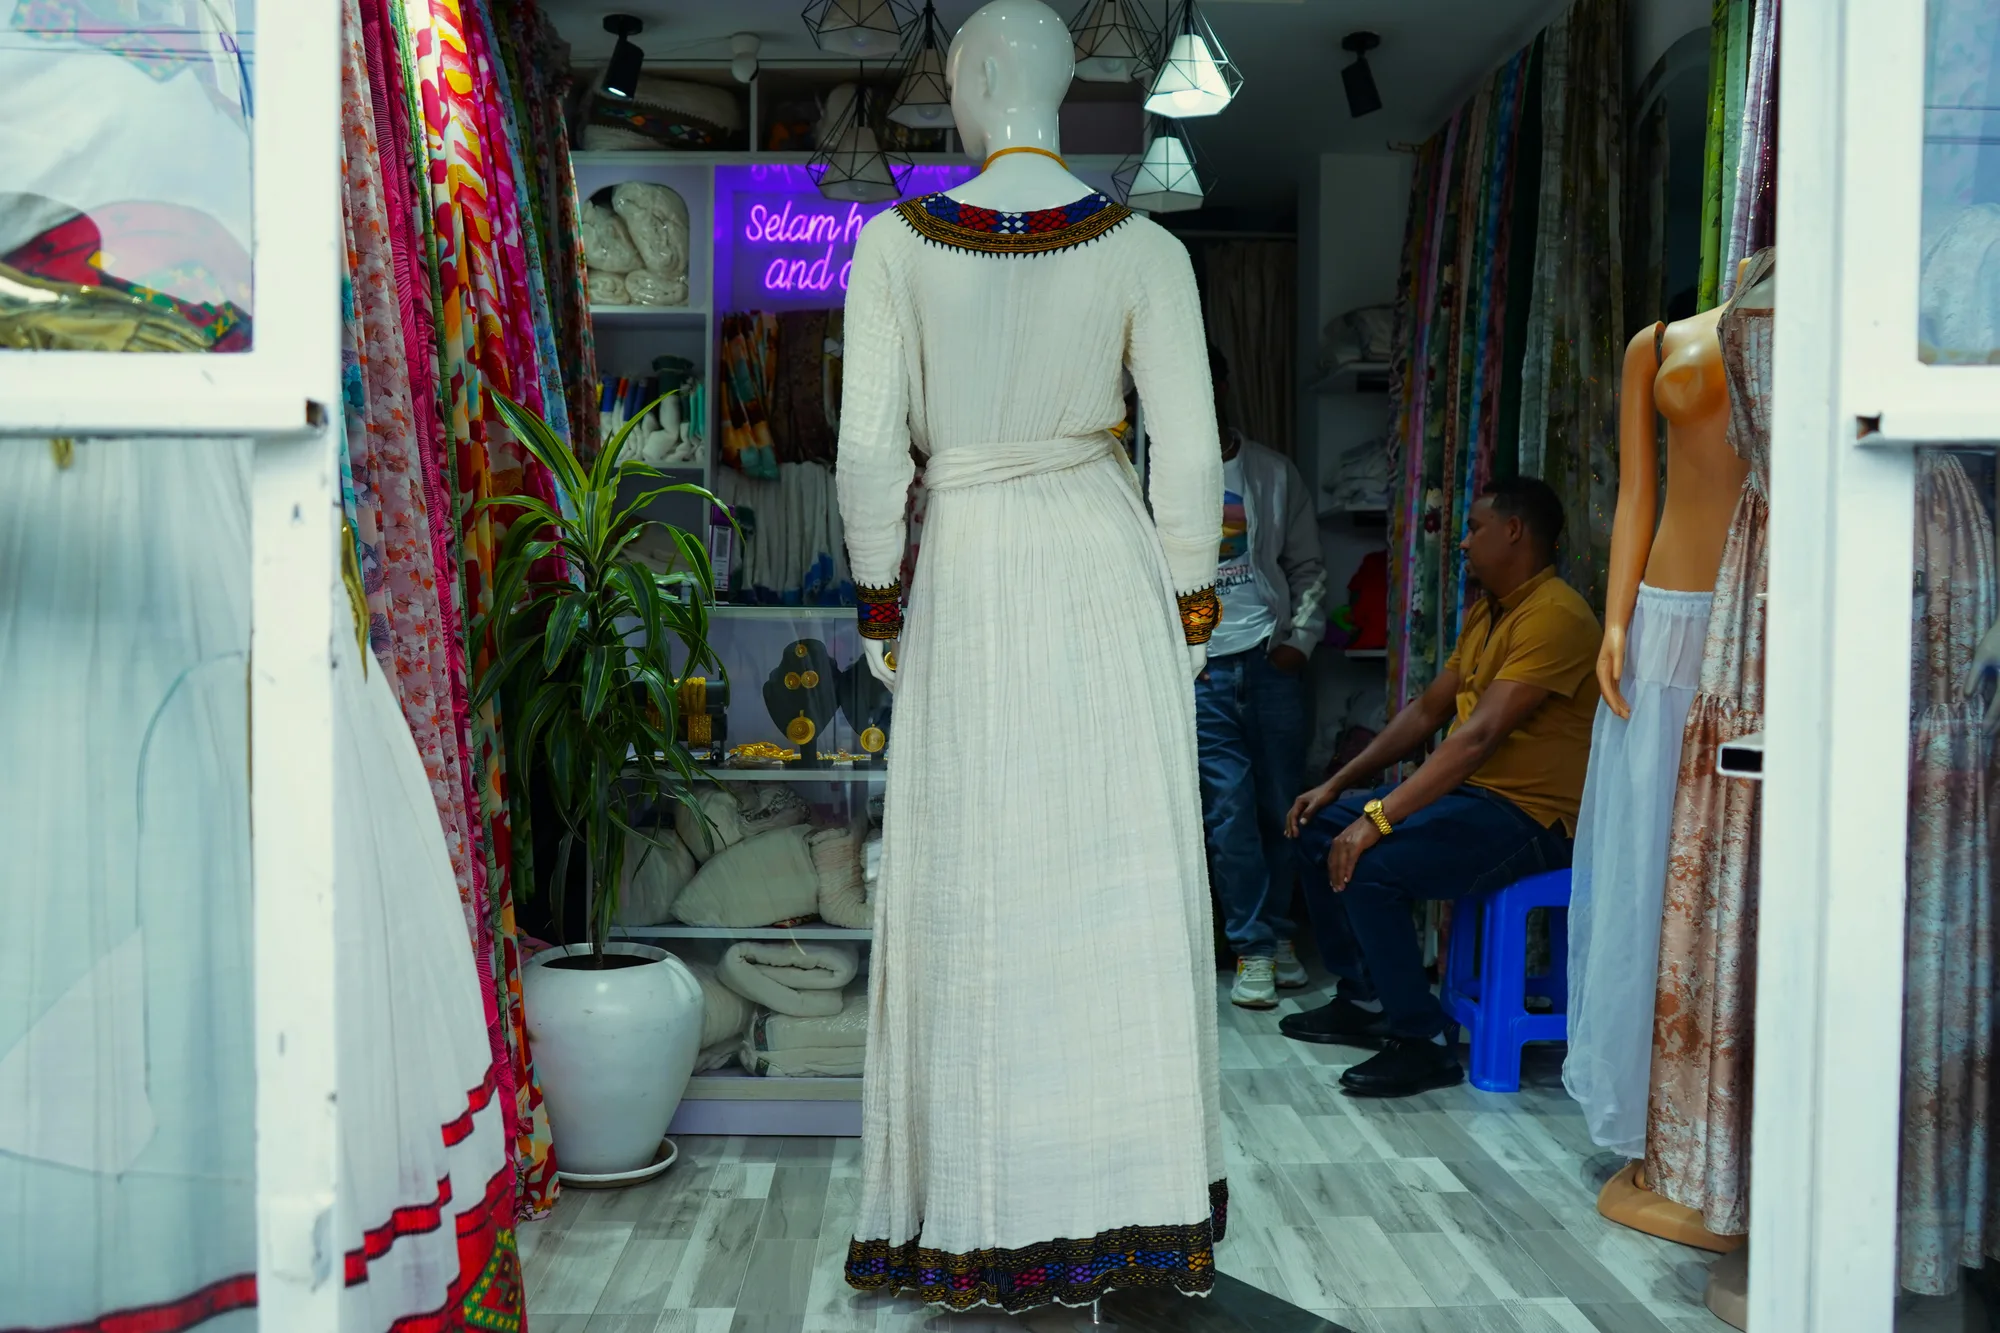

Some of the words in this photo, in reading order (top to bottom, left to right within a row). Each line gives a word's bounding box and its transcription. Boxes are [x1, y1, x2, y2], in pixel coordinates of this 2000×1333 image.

[745, 201, 842, 243] Selam
[764, 244, 835, 290] and
[1215, 587, 1231, 596] 020
[1216, 574, 1253, 588] RALIA
